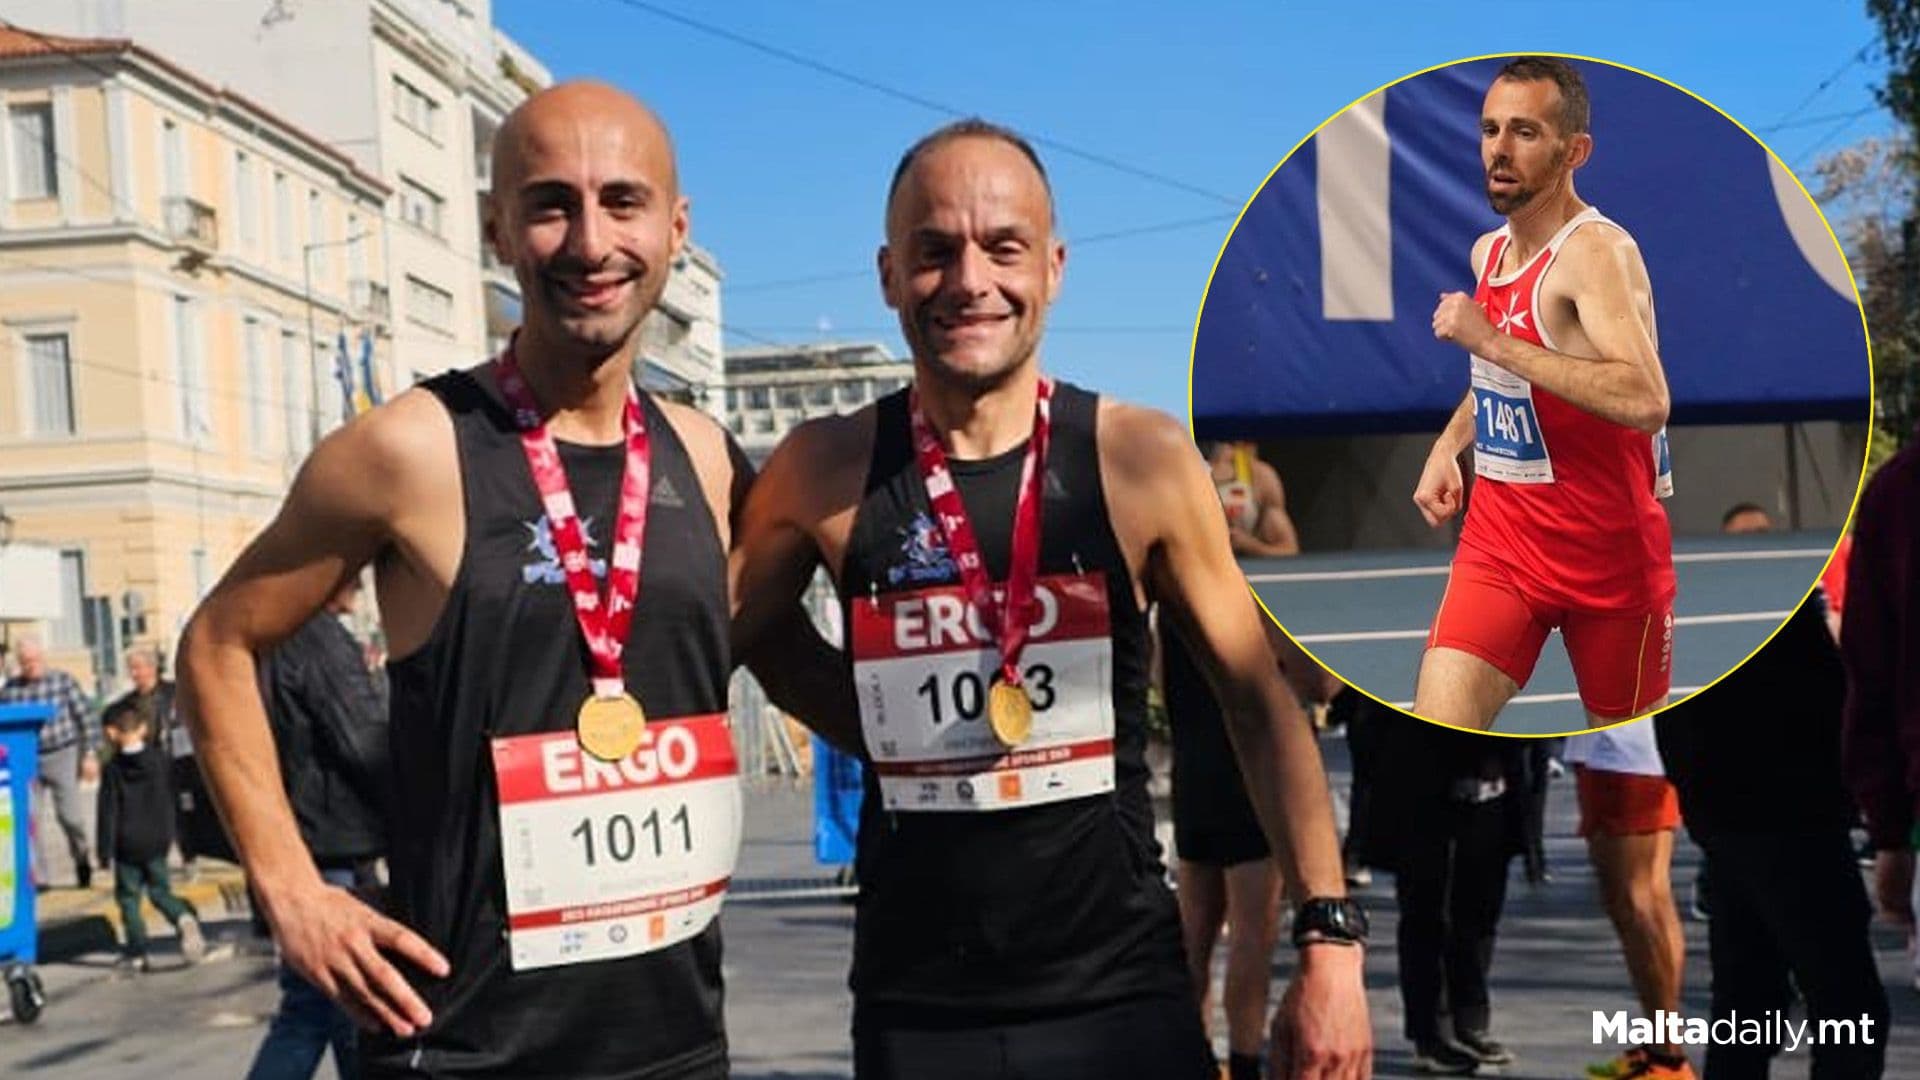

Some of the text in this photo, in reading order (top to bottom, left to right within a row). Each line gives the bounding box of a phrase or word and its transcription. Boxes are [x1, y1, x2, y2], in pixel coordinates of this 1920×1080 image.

[1482, 397, 1533, 444] 1481
[918, 664, 1055, 723] 103
[571, 803, 692, 867] 1011
